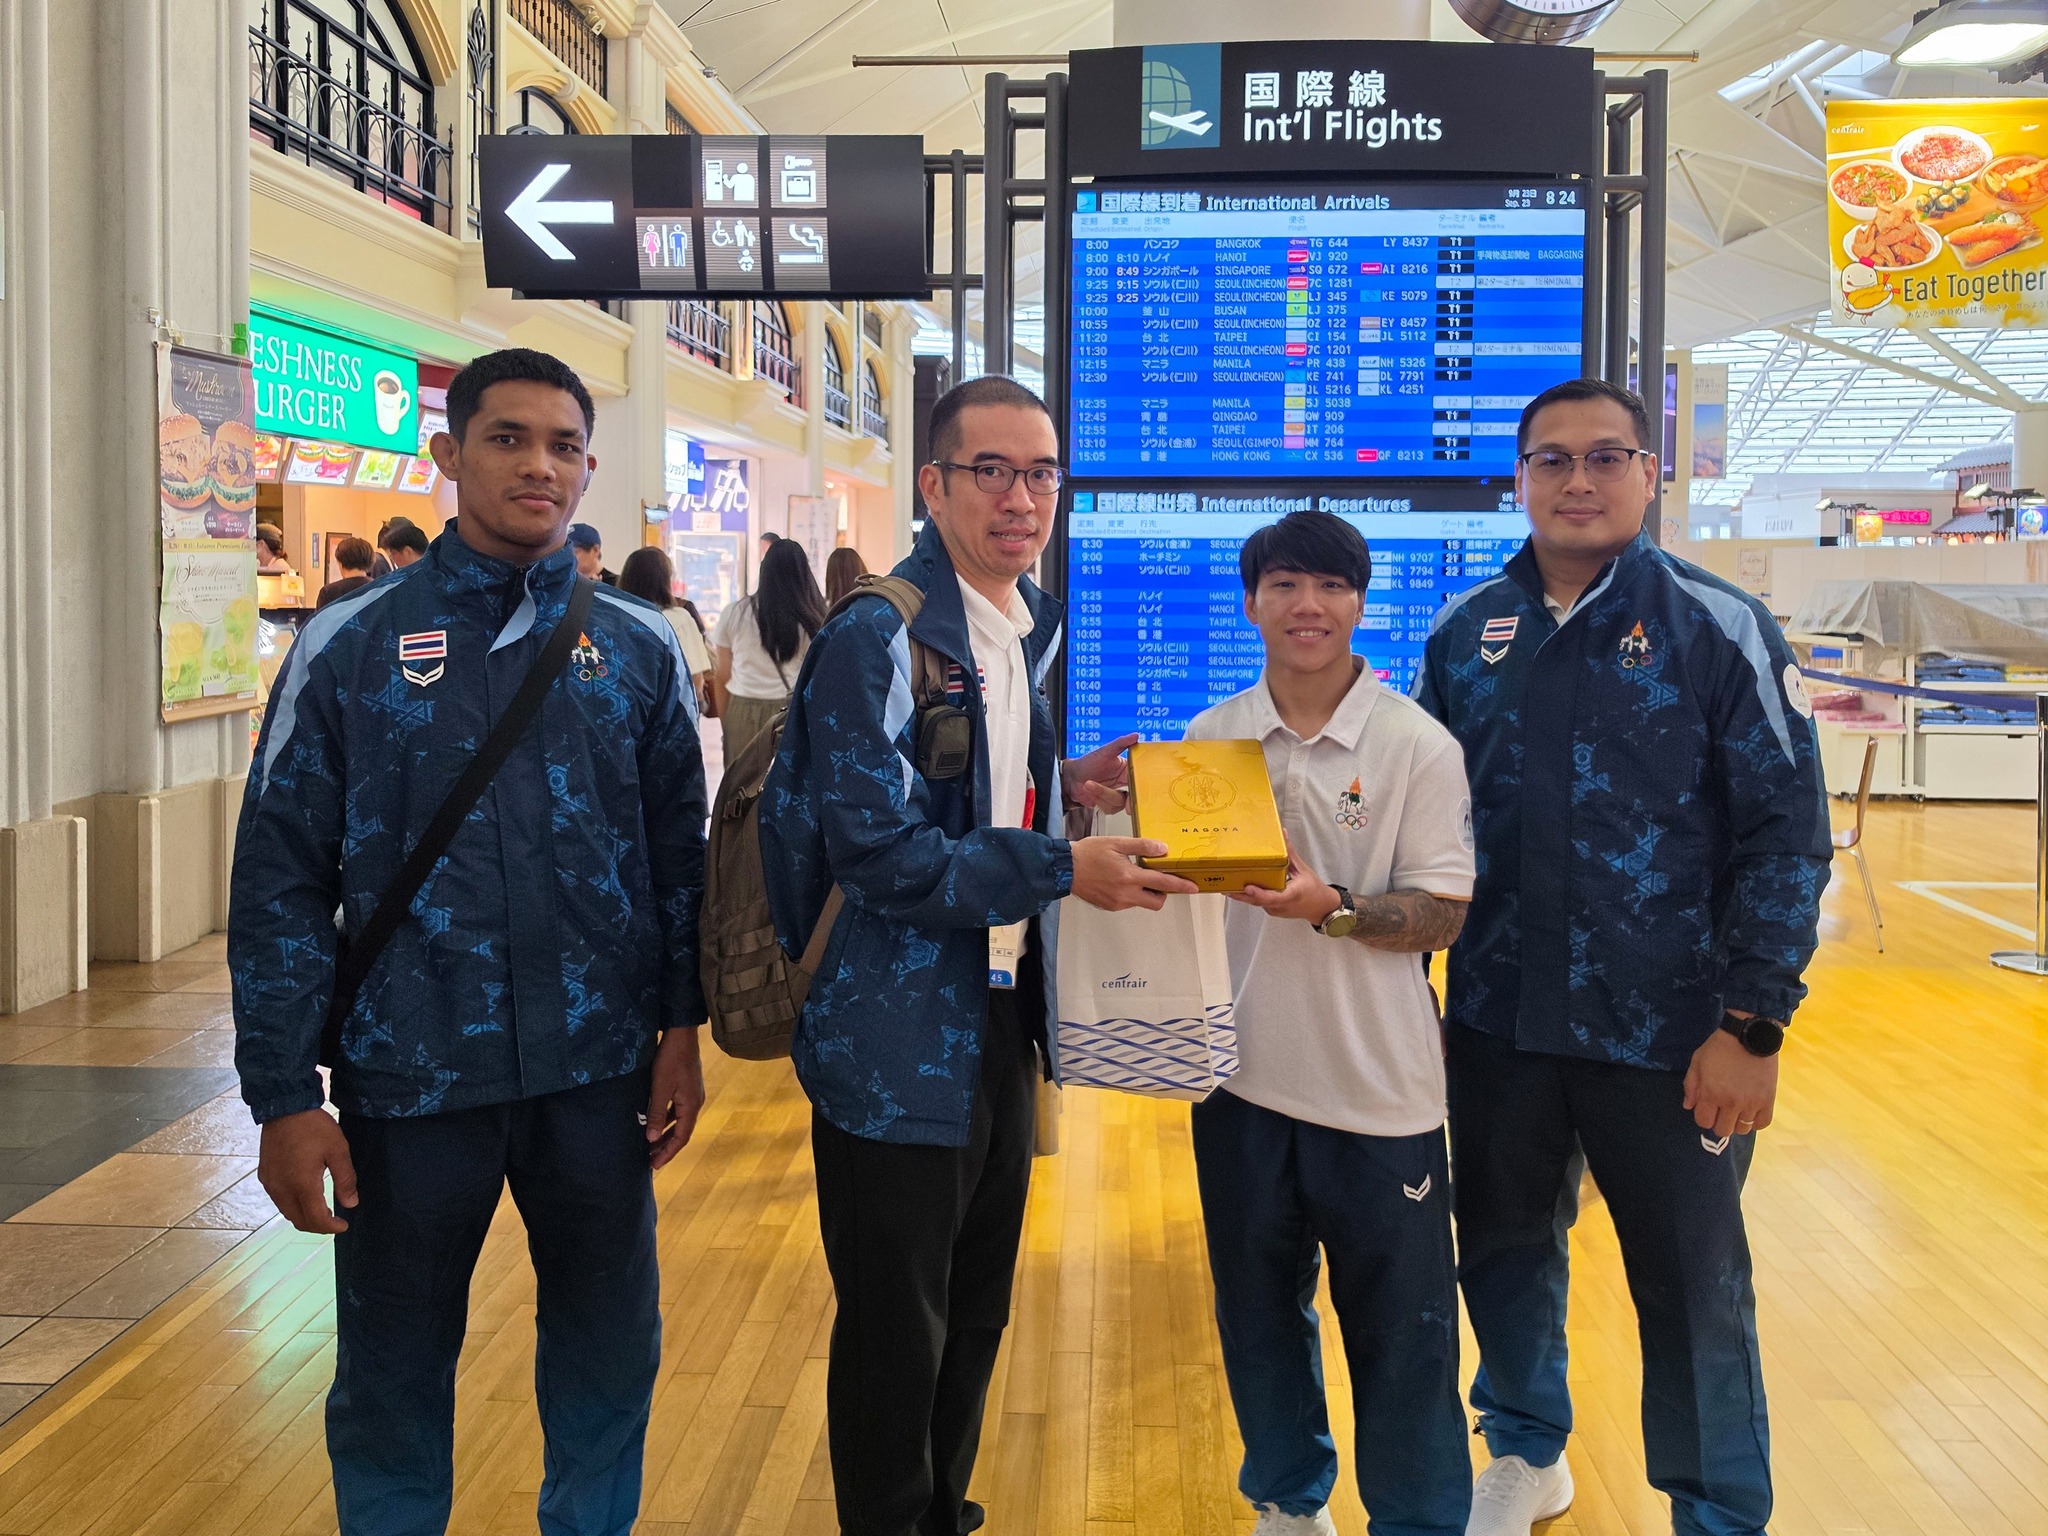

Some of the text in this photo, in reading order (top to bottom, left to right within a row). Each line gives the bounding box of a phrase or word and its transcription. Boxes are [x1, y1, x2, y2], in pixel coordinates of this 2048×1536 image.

[1243, 70, 1387, 108] 国際線
[1324, 108, 1443, 148] Flights
[1100, 192, 1390, 212] 国際線到着 International Arrivals
[1521, 199, 1531, 208] 23
[1085, 240, 1109, 250] 8:00
[1215, 239, 1261, 249] BANGKOK
[1310, 238, 1323, 249] TG
[1328, 238, 1349, 248] 644
[1383, 237, 1397, 248] LY
[1402, 237, 1429, 248] 8437
[1085, 253, 1109, 264] 8:00
[1116, 253, 1139, 264] 8:10
[1215, 252, 1247, 263] HANOI
[1309, 251, 1322, 262] VJ
[1327, 251, 1349, 262] 920
[1085, 266, 1108, 277] 9:00
[1116, 266, 1139, 277] 8:49
[1214, 265, 1271, 276] SINGAPORE
[1309, 264, 1322, 275] SQ
[1327, 264, 1348, 275] 672
[1383, 264, 1395, 274] AI
[1401, 264, 1429, 274] 8216
[1085, 280, 1108, 290] 9:25
[1116, 279, 1139, 290] 9:15
[1309, 278, 1322, 288] 7C
[1328, 277, 1353, 288] 1281
[1903, 268, 2047, 302] Eat Together
[1085, 293, 1108, 304] 9:25
[1116, 293, 1139, 303] 9:25
[1308, 291, 1321, 302] LJ
[1327, 291, 1348, 301] 345
[1382, 290, 1396, 301] KE
[1401, 290, 1428, 301] 5079
[1079, 304, 1347, 317] 10:00 BUSAN LJ 375
[1079, 320, 1108, 330] 10:55
[1308, 318, 1321, 328] OZ
[1327, 318, 1347, 328] 122
[1381, 317, 1395, 328] EY
[1400, 317, 1427, 327] 8457
[1079, 333, 1108, 344] 11:20
[1214, 332, 1248, 342] TAIPEI
[1307, 331, 1320, 342] CI
[1327, 331, 1347, 342] 154
[1381, 330, 1394, 341] JL
[1400, 330, 1427, 341] 5112
[1079, 344, 1351, 357] 11:30 7C 1201
[249, 330, 362, 393] ESHNESS
[1079, 359, 1108, 370] 12:15
[1213, 358, 1251, 369] MANILA
[1307, 357, 1320, 368] PR
[1325, 357, 1346, 368] 438
[1380, 357, 1394, 367] NH
[1399, 356, 1426, 367] 5326
[1079, 370, 1425, 383] 12:30 KE 741 DL 7791
[1306, 383, 1424, 395] JL 5216 KL 4251
[252, 378, 347, 432] URGER
[1078, 399, 1107, 410] 12:35
[1212, 398, 1250, 408] MANILA
[1078, 412, 1107, 423] 12:45
[1212, 411, 1258, 422] QINGDAO
[1324, 410, 1345, 421] 909
[1078, 423, 1344, 436] 12:55 TAIPEI IT 206
[1078, 439, 1106, 449] 13:10
[1324, 437, 1344, 447] 764
[1078, 449, 1424, 462] 15:05 HONG KONG CX 536 QF 8213
[1097, 492, 1412, 513] 国際線出発 International Departures
[1409, 552, 1434, 563] 9707
[1409, 566, 1434, 576] 7794
[1101, 973, 1148, 989] centrair
